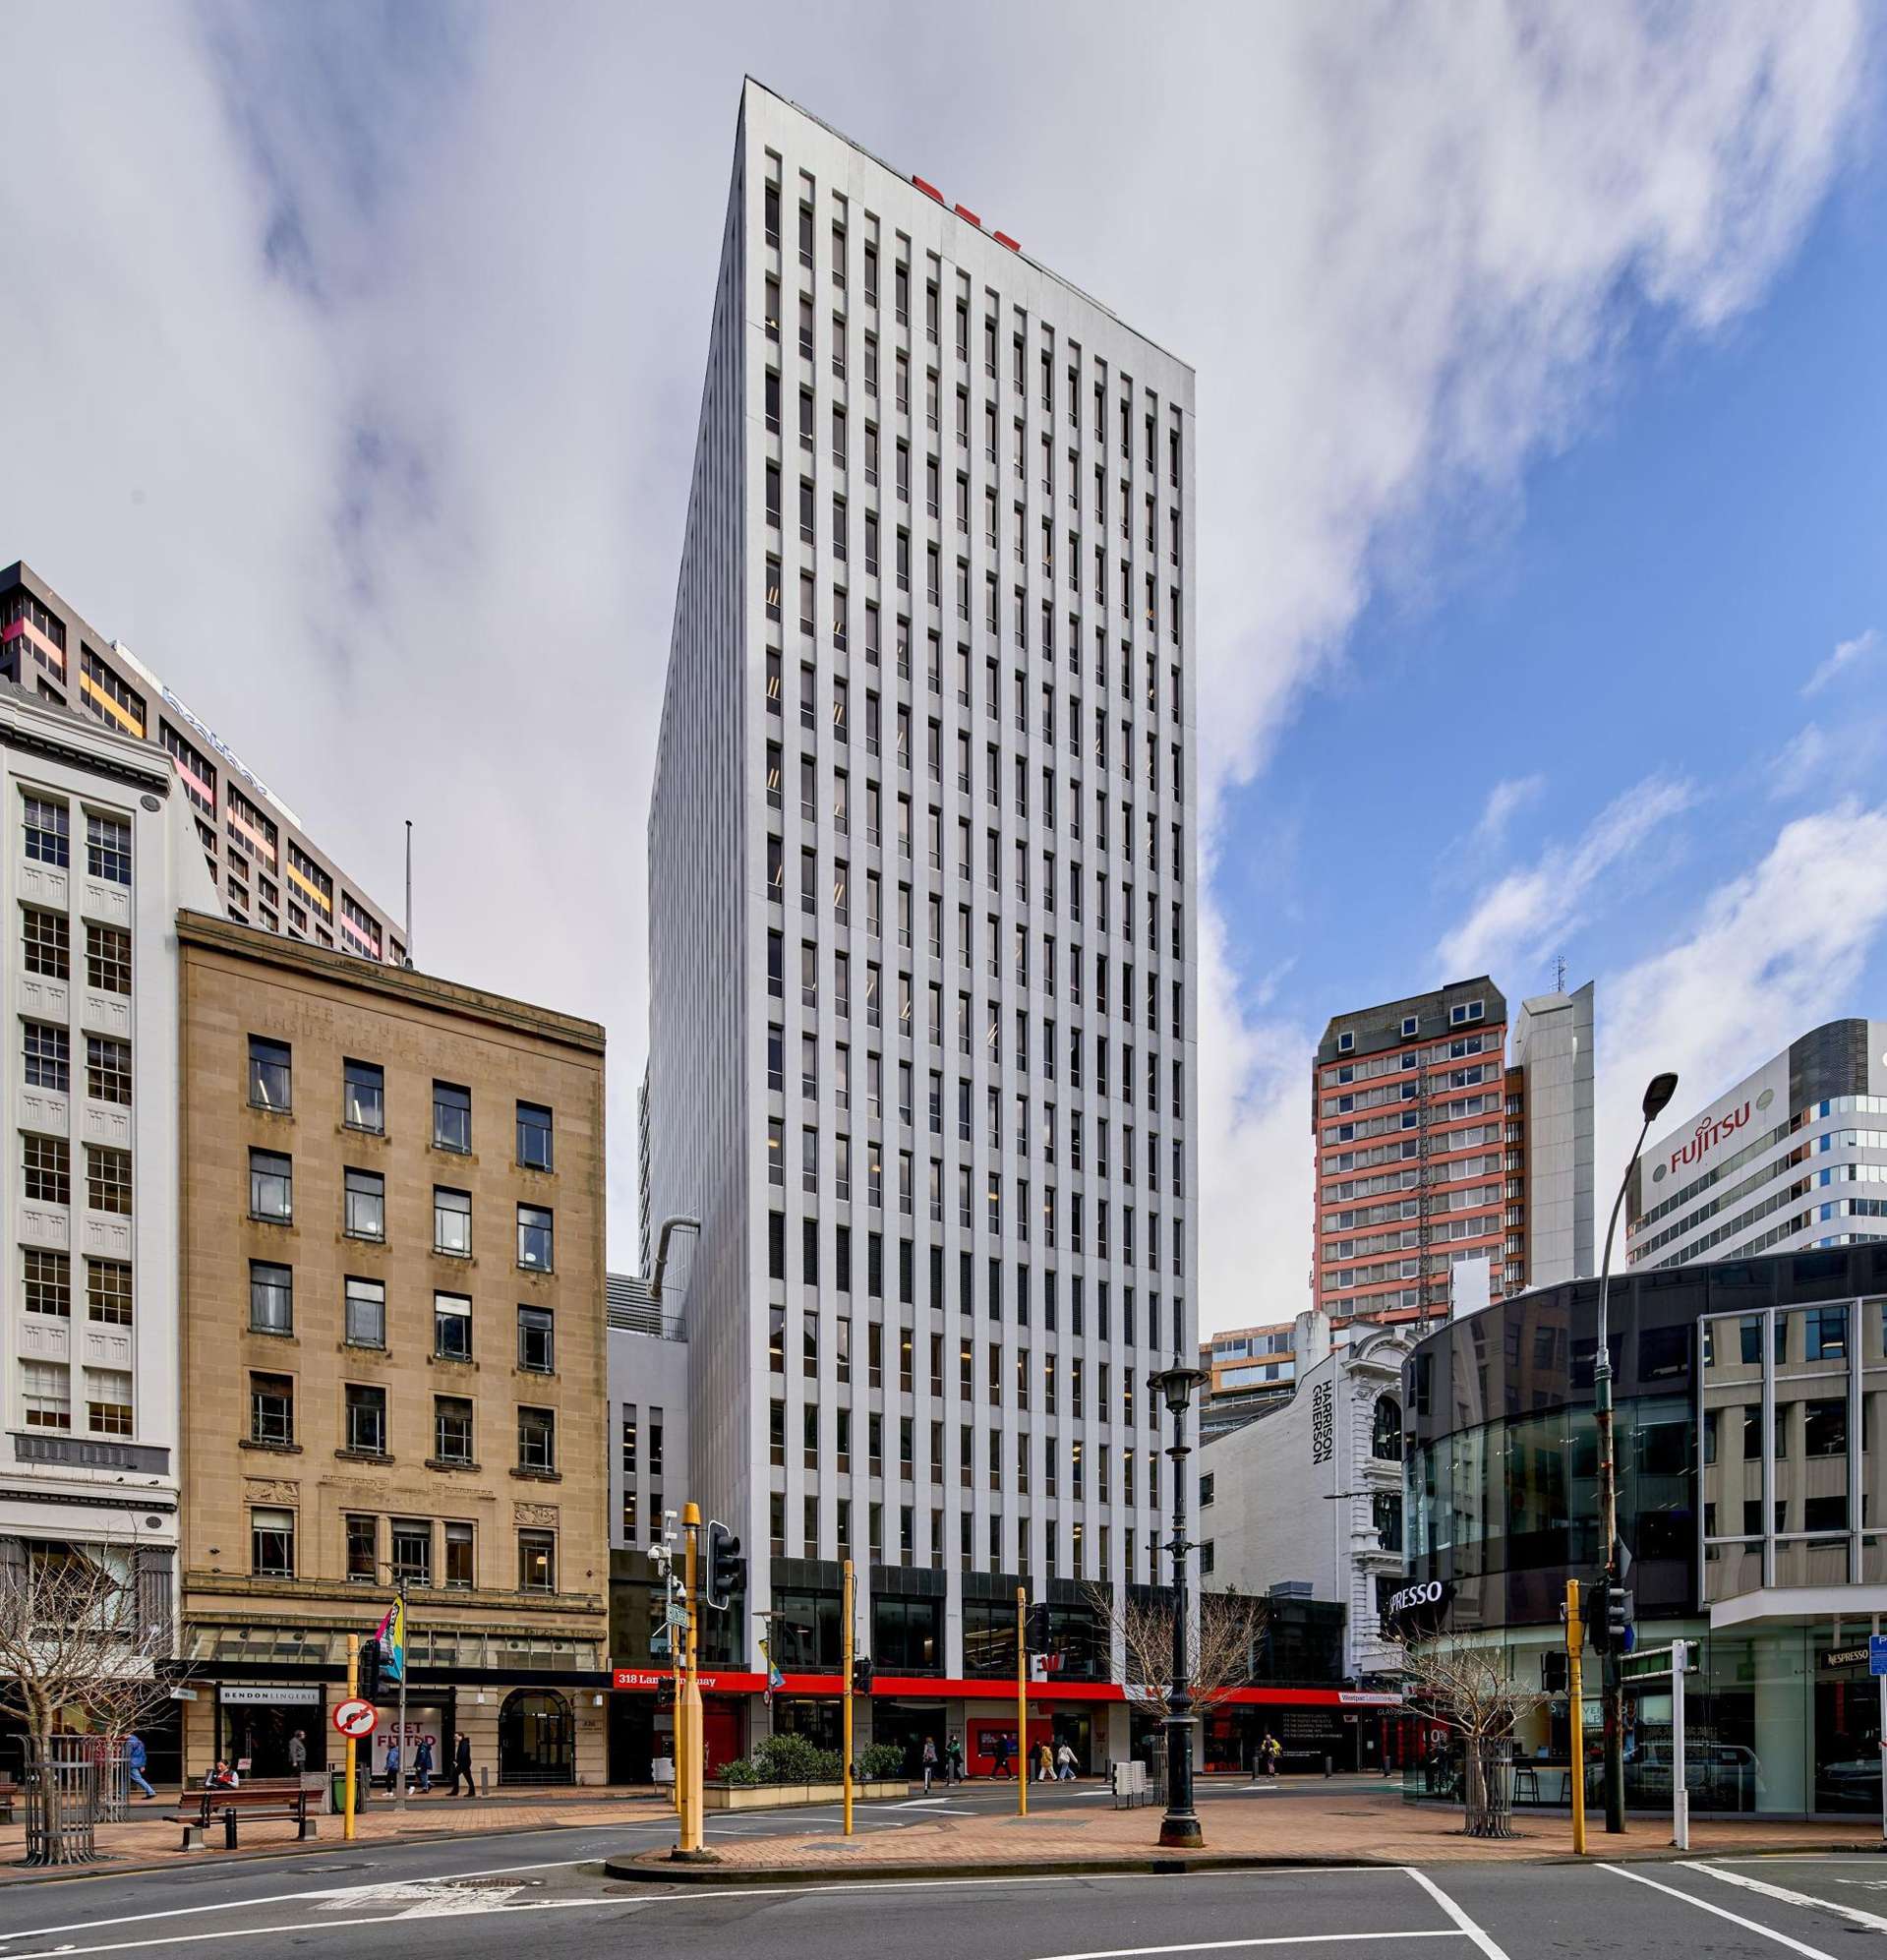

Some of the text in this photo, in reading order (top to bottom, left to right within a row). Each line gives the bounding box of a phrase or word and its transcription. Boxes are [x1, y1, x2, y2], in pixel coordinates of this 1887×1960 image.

[1671, 1100, 1750, 1174] FUJITSU
[1313, 1385, 1323, 1465] GRIERSON
[1323, 1380, 1332, 1462] HARRISON
[1828, 1649, 1868, 1666] NESPRESSO
[619, 1674, 637, 1684] 318
[694, 1675, 716, 1688] uay
[390, 1722, 424, 1734] GET
